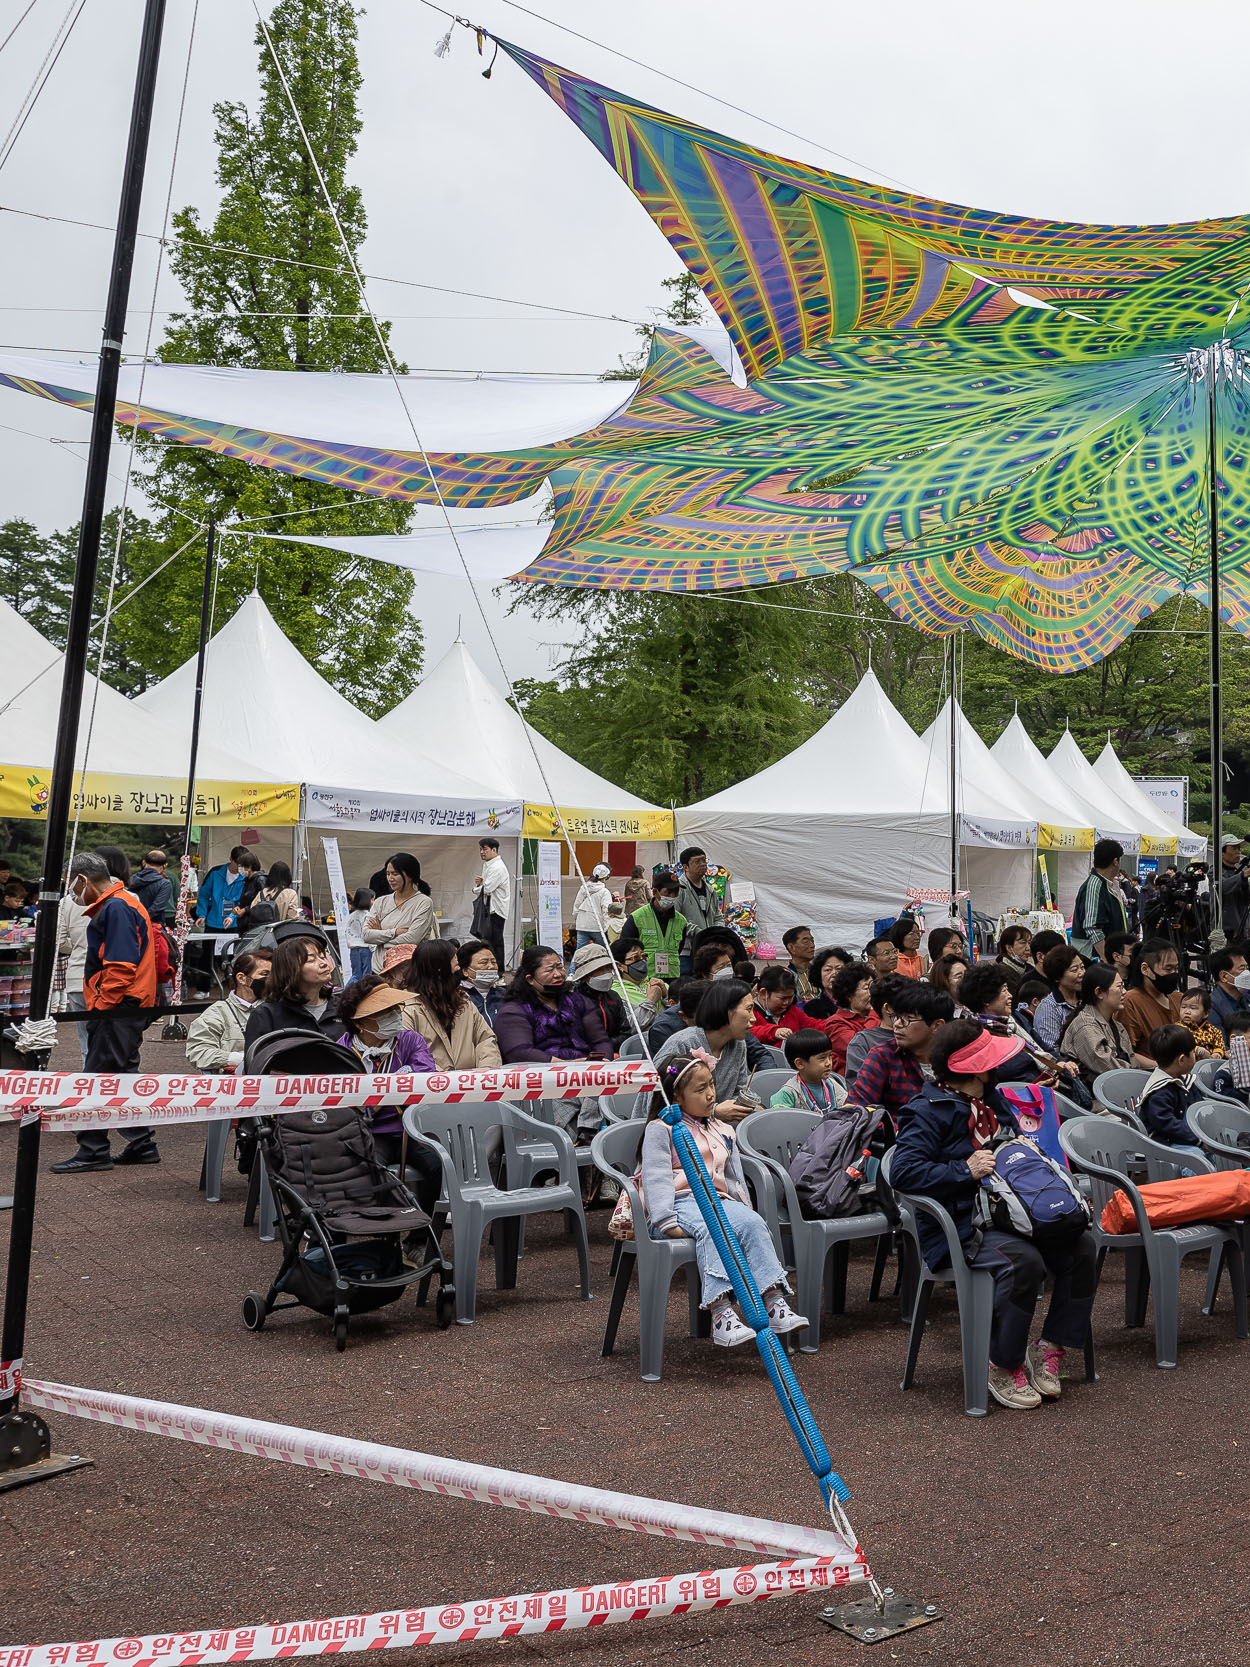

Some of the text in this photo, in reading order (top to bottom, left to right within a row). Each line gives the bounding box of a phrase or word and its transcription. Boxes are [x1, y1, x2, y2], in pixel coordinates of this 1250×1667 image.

[130, 792, 174, 813] 장난감
[369, 808, 476, 827] 업싸이클의 시작 장난감분해
[619, 819, 641, 834] 전시관
[73, 1078, 121, 1096] 위험
[168, 1078, 262, 1096] 안전제일
[275, 1077, 361, 1095] DANGER!
[372, 1076, 414, 1094] 위험
[458, 1071, 543, 1091] 안전제일
[46, 1644, 101, 1665] 위험
[151, 1630, 256, 1657] 안전제일
[271, 1617, 365, 1646] DANGER!
[378, 1610, 426, 1635] 위험
[473, 1594, 568, 1625] 안전제일
[582, 1583, 667, 1613] DANGER!
[678, 1576, 721, 1602] 위험
[765, 1564, 851, 1592] 안전제일
